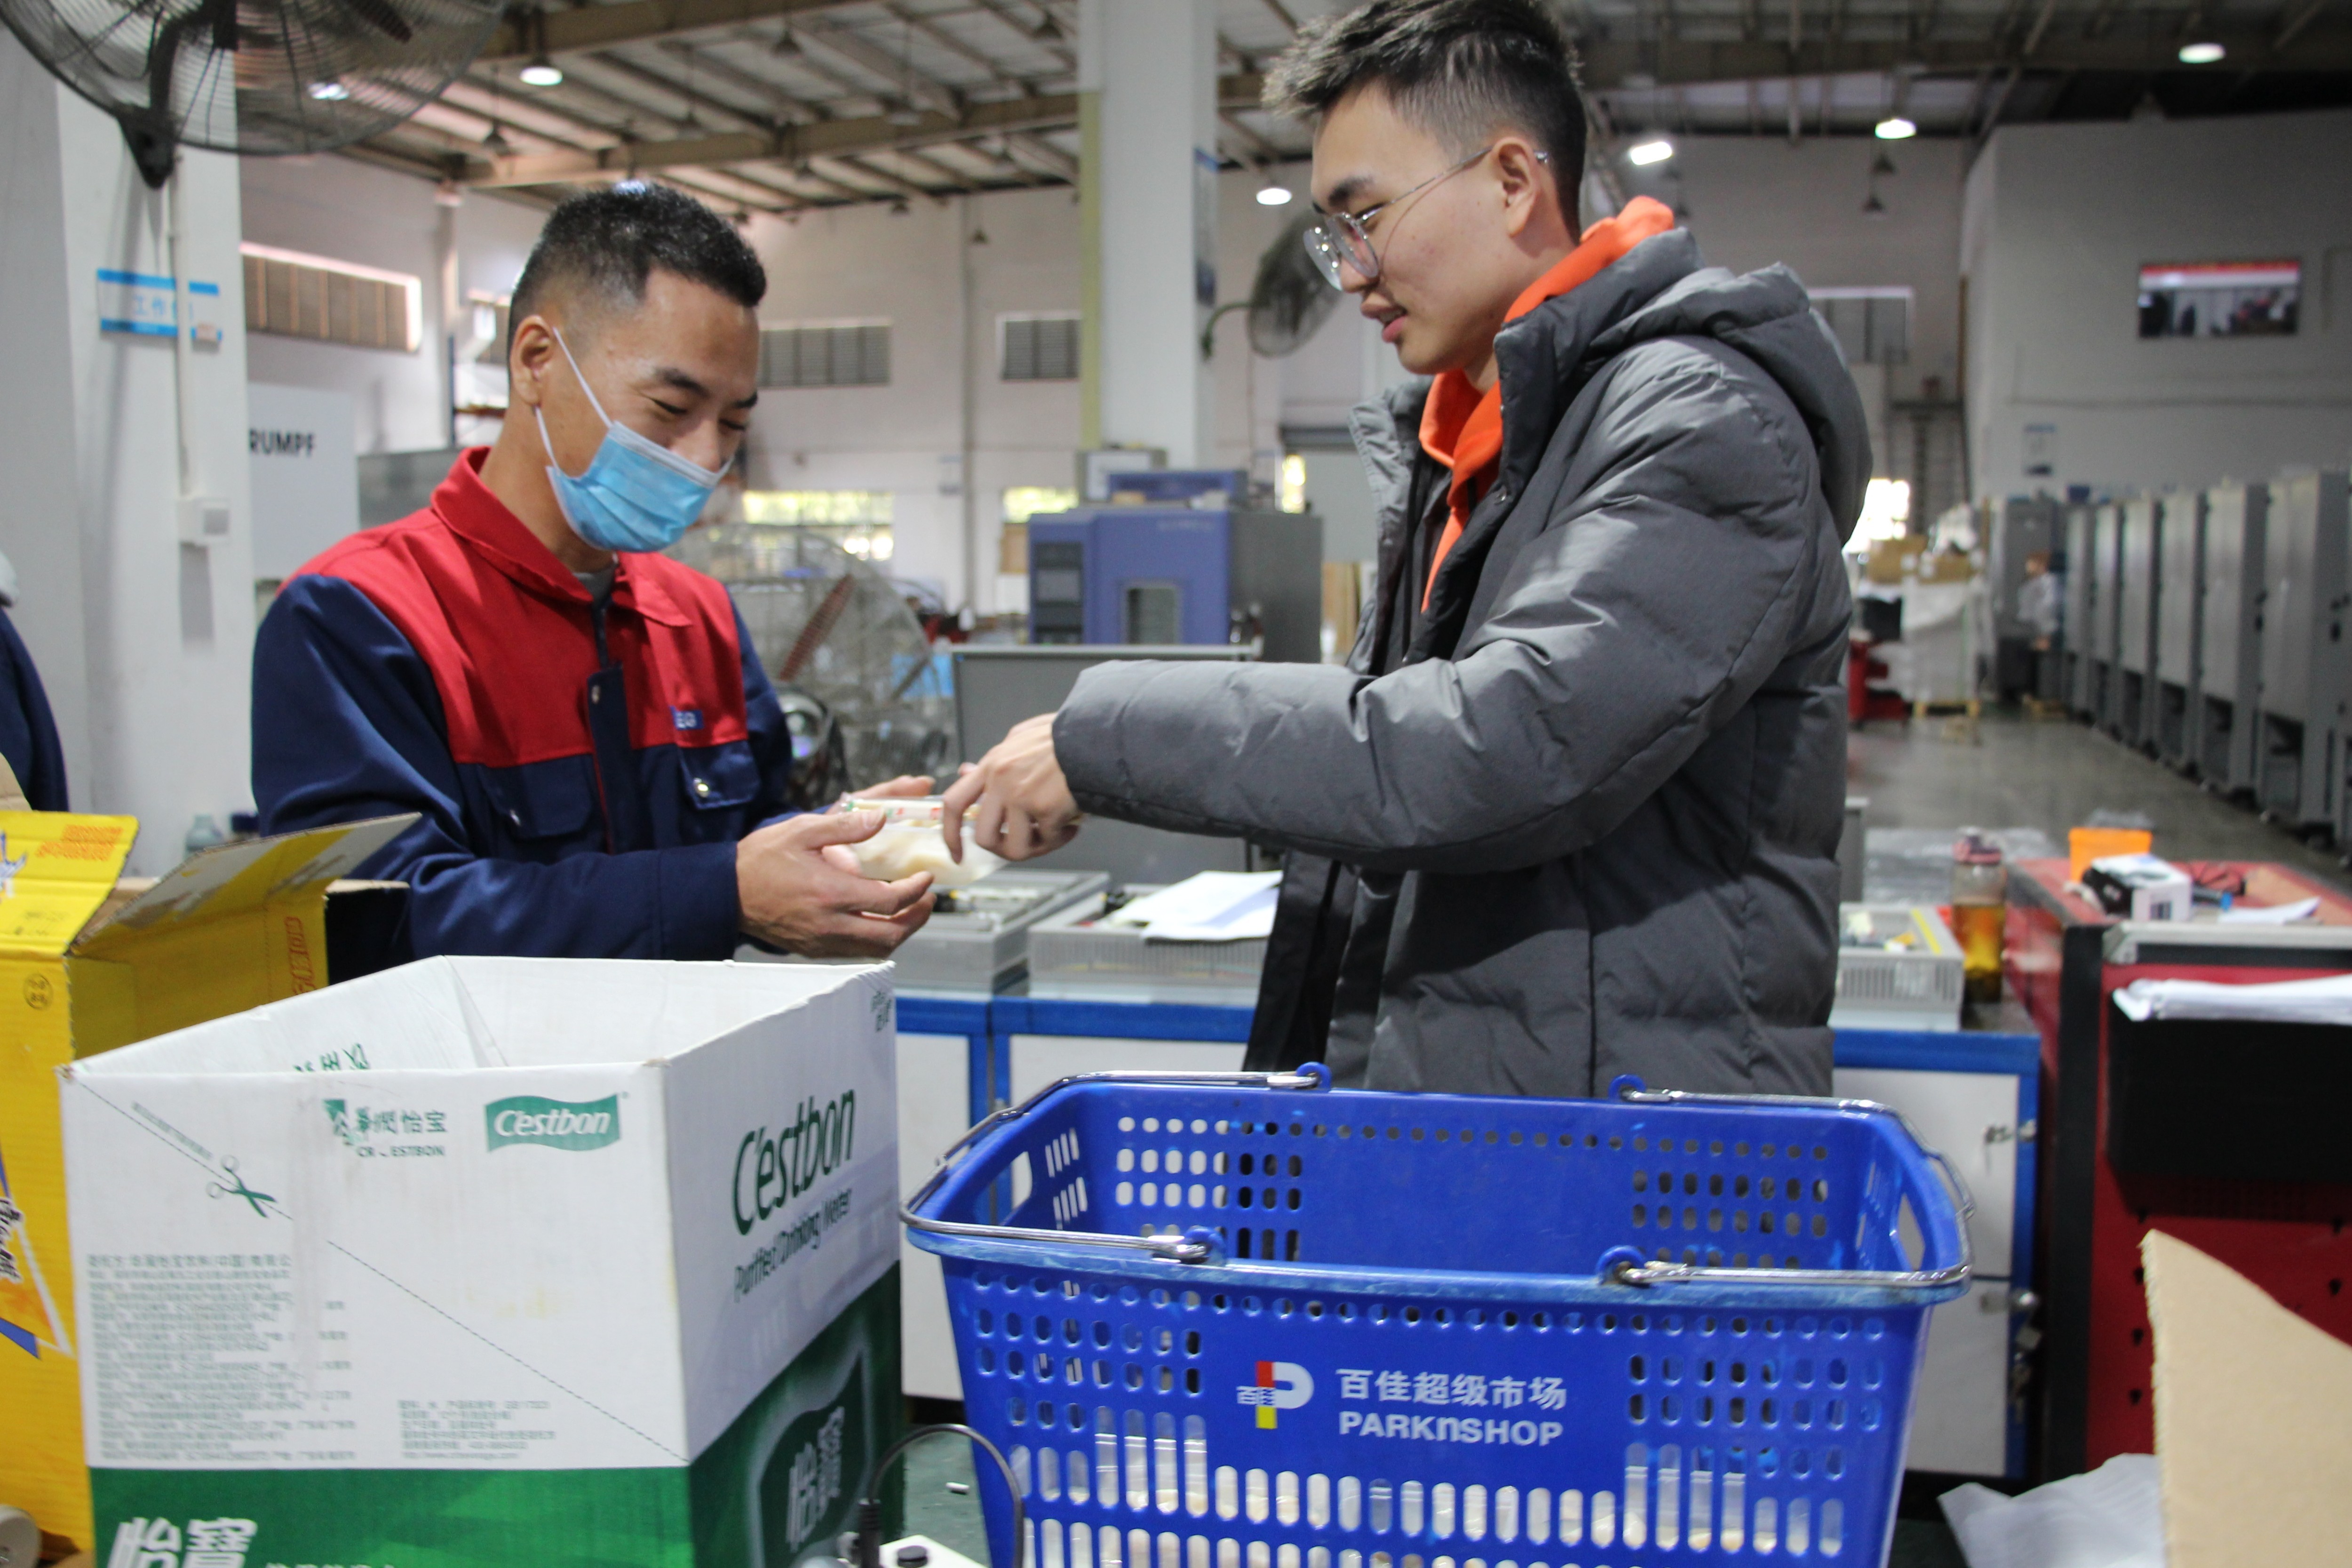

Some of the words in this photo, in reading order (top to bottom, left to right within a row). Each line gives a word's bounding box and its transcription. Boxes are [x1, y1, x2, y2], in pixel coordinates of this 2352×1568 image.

[1335, 1368, 1567, 1411] 百佳超级市场
